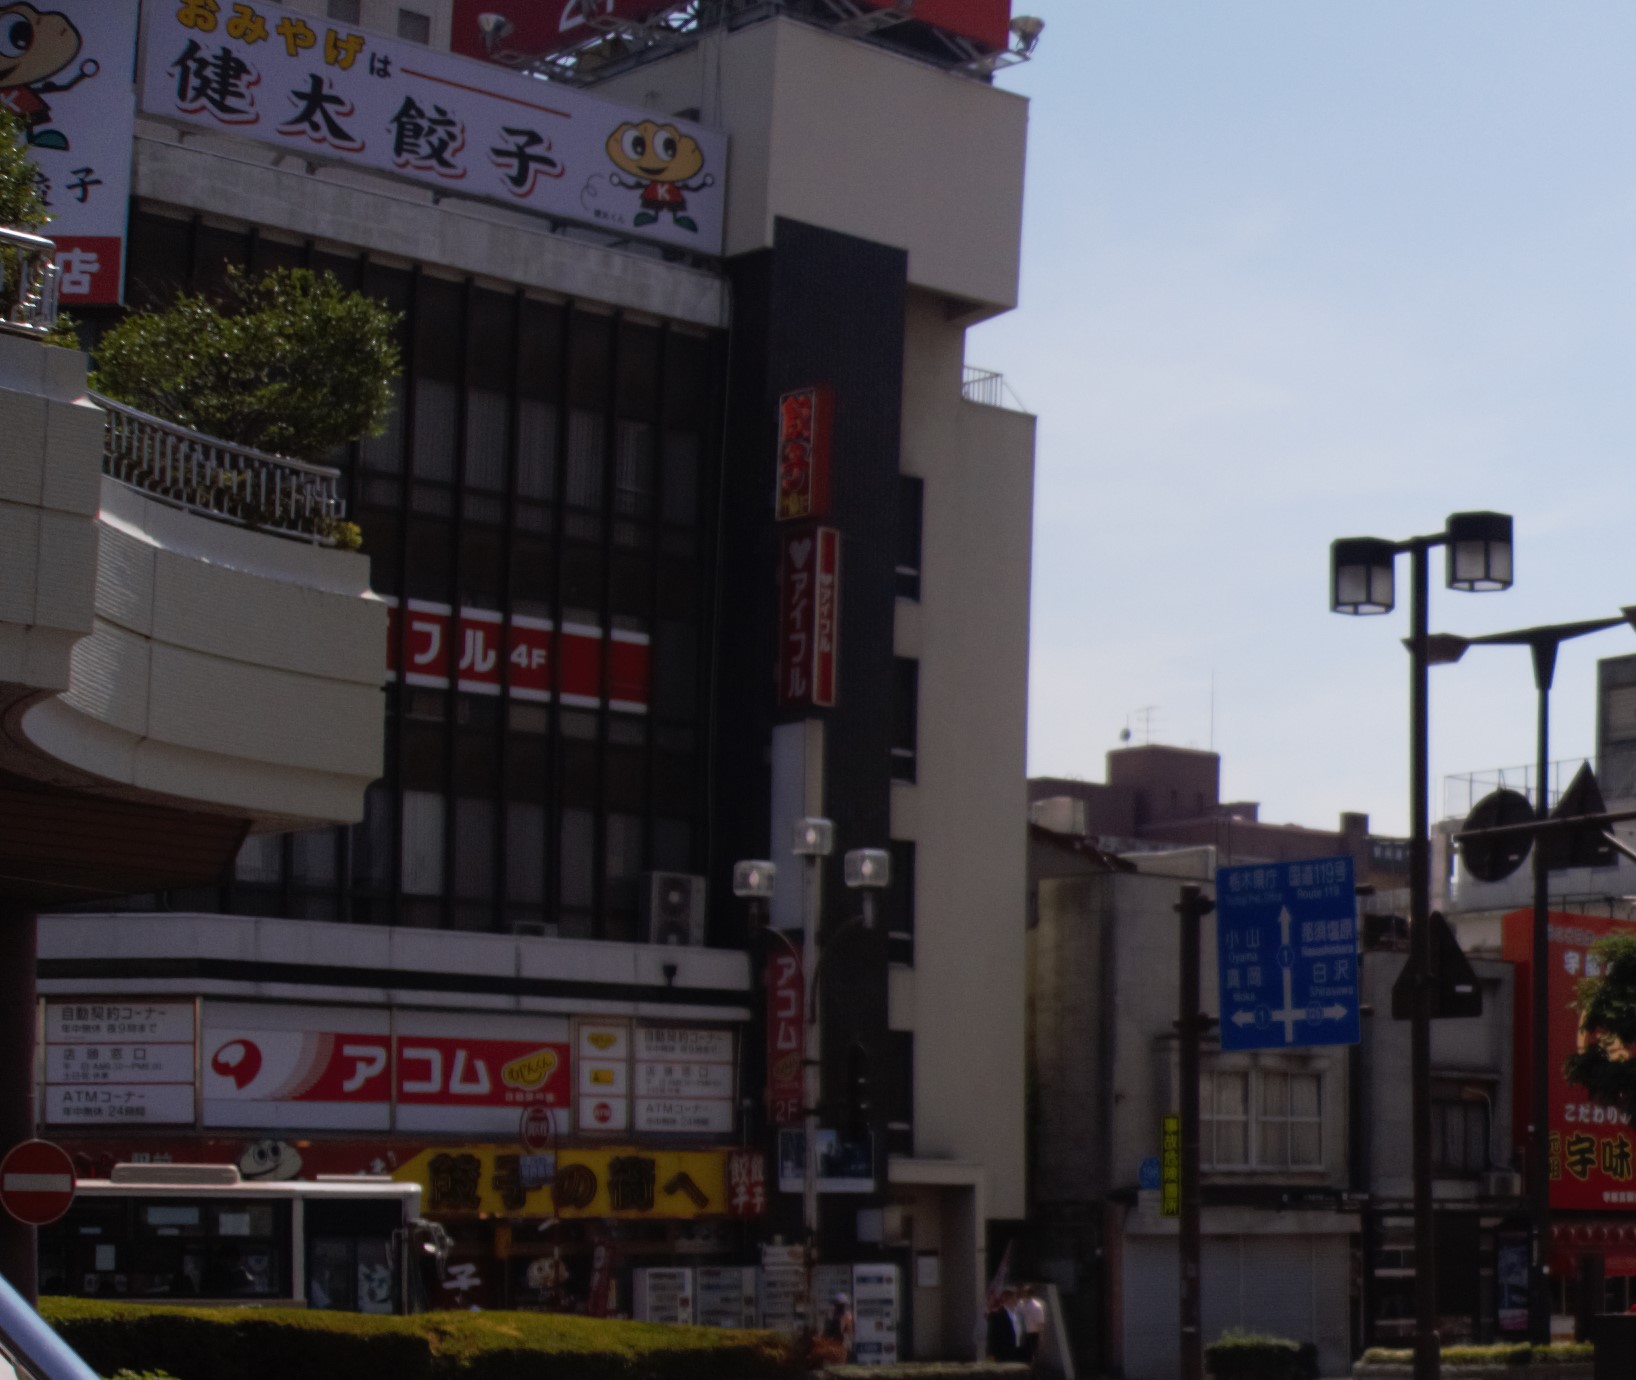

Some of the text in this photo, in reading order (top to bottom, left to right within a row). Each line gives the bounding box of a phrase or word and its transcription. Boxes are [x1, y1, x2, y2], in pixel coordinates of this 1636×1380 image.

[176, 0, 393, 80] おみやげは
[172, 38, 564, 198] 健太餃子
[56, 248, 99, 293] 店
[790, 573, 807, 698] アイフル
[1225, 928, 1260, 949] 小山
[1312, 959, 1349, 983] 白沢
[62, 1007, 166, 1022] 自動契約コーナー
[777, 956, 797, 1050] アコム
[341, 1044, 492, 1097] アコム
